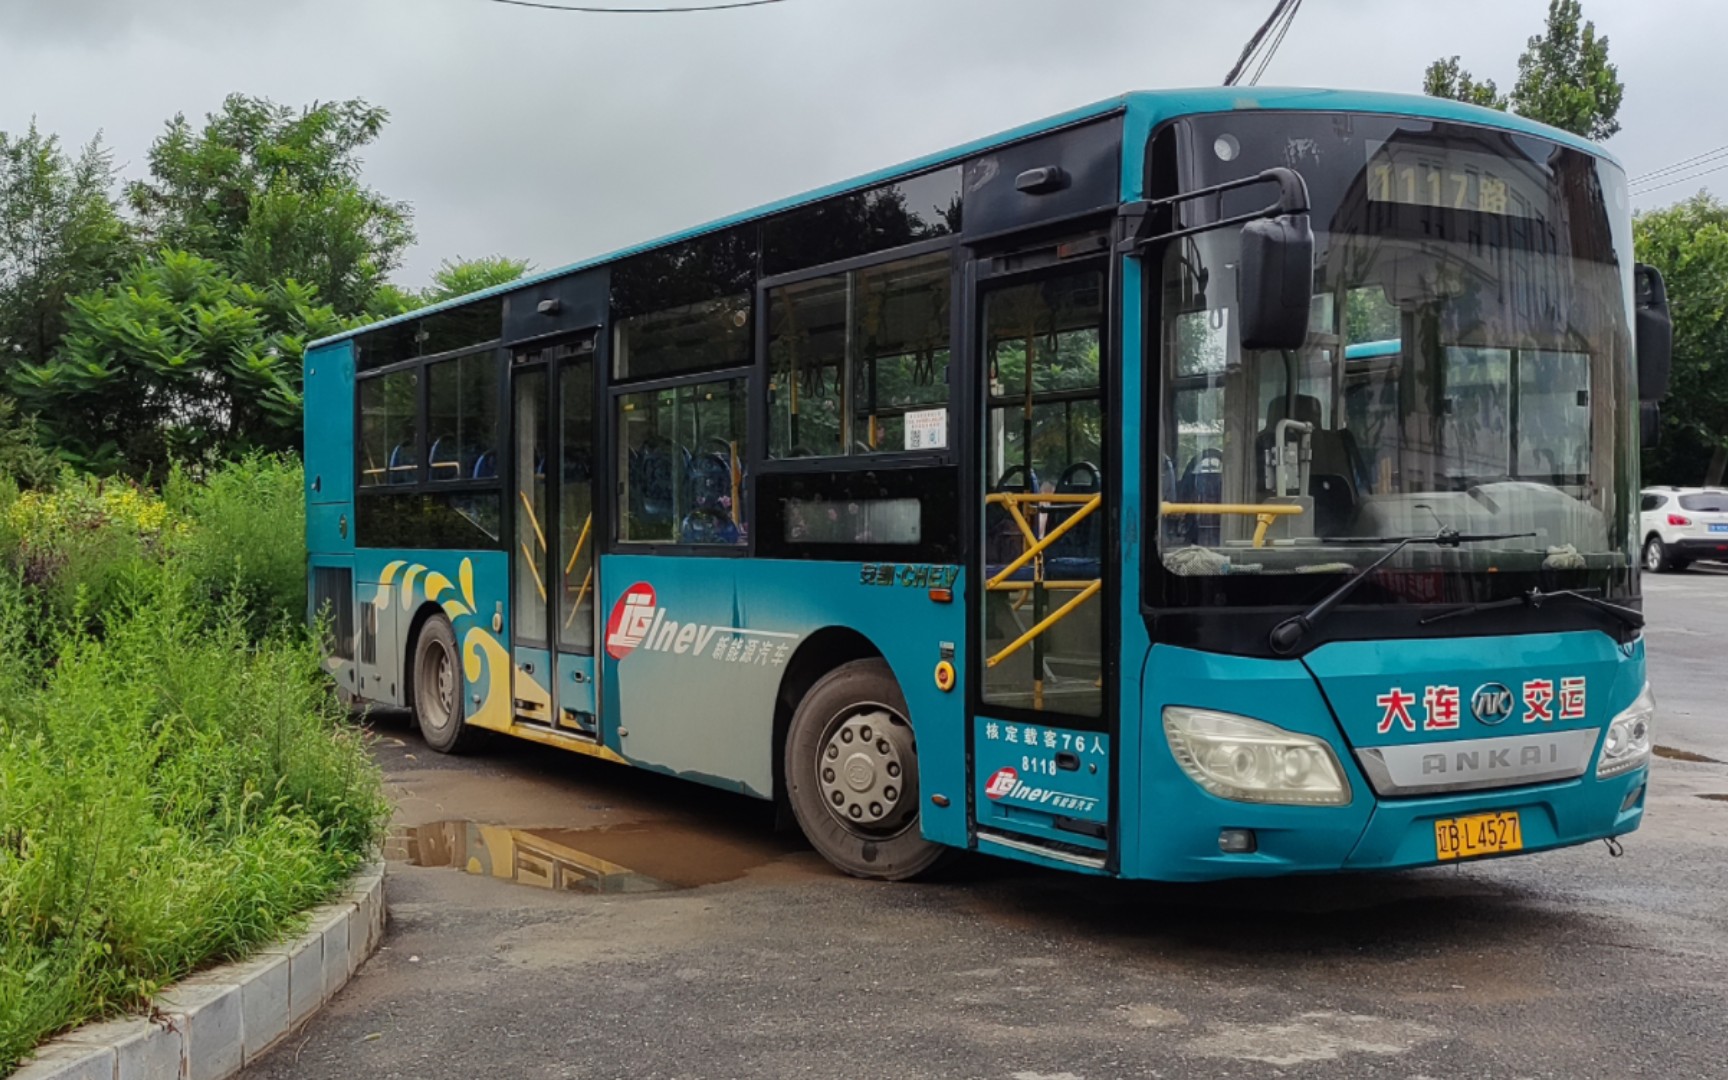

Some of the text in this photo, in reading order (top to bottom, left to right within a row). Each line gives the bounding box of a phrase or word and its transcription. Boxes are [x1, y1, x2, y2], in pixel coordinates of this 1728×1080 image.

[1375, 165, 1508, 215] 1117路
[711, 636, 789, 667] 新能源汽车
[1377, 685, 1460, 734] 大连
[1522, 676, 1586, 724] 交运
[1021, 755, 1057, 776] 8118
[1422, 744, 1557, 776] ANKAI
